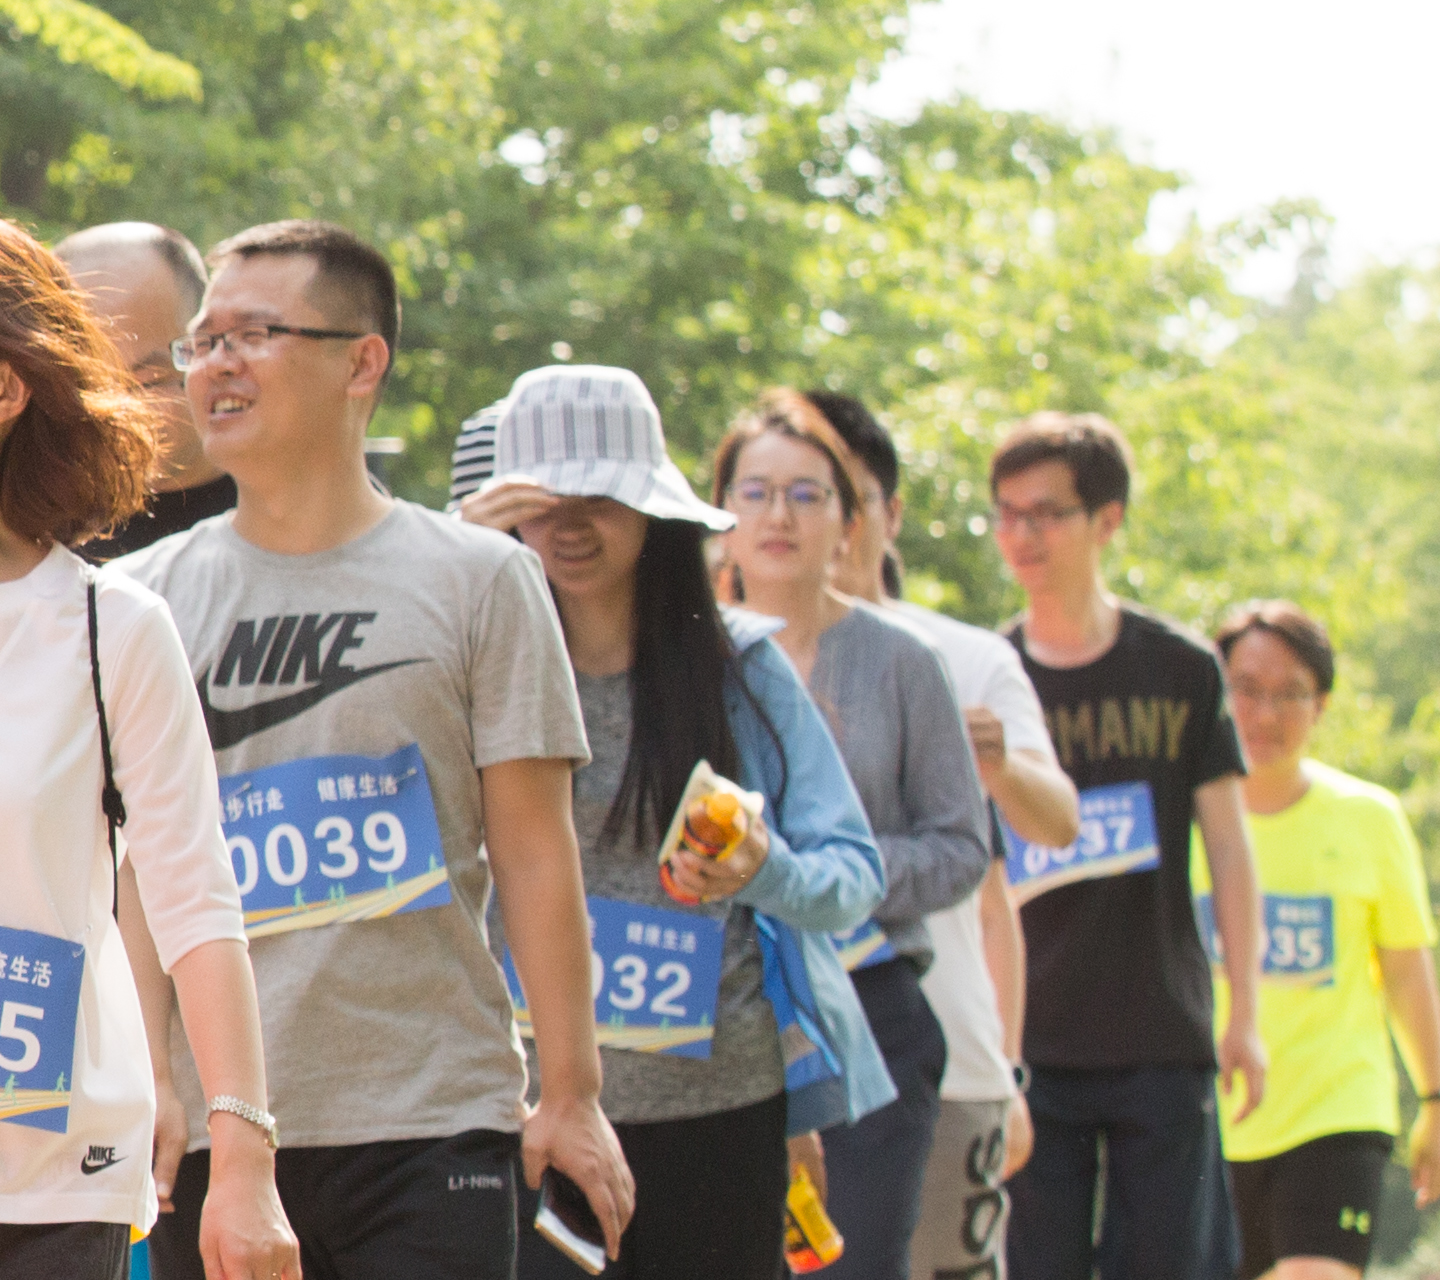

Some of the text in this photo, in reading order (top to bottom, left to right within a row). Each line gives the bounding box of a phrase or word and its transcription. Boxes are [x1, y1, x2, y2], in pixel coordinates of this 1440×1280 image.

[213, 611, 378, 687] NIKE
[1046, 696, 1191, 766] MANY
[226, 811, 408, 897] 0039
[591, 950, 692, 1018] 32
[88, 1145, 115, 1163] NIKE
